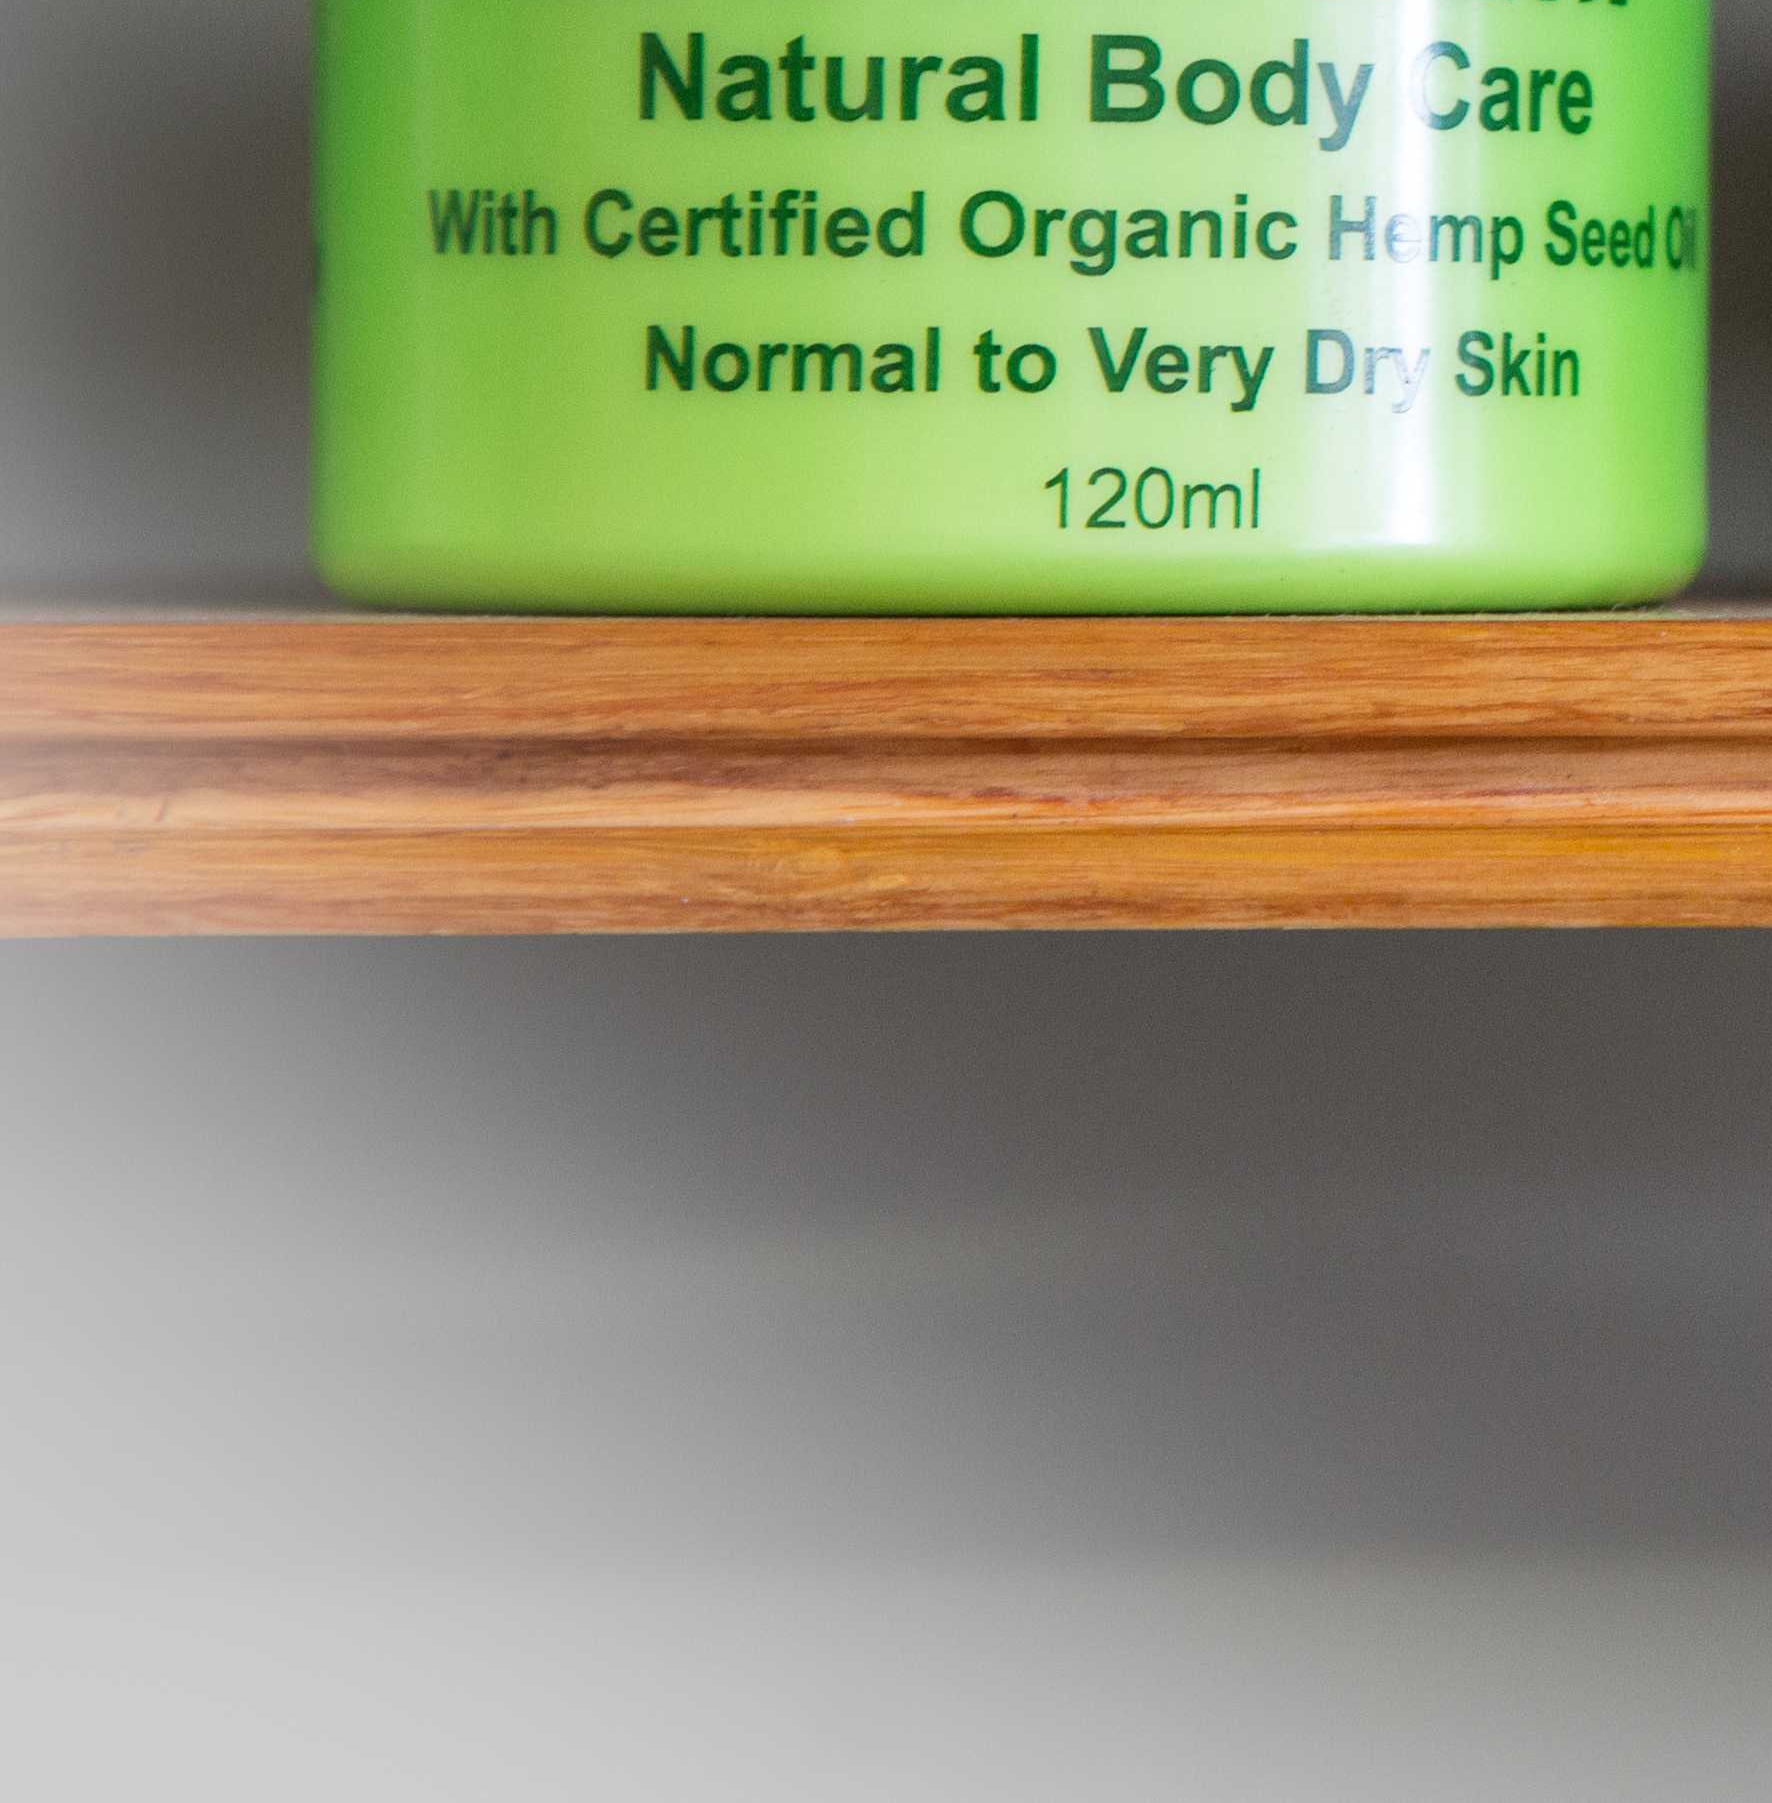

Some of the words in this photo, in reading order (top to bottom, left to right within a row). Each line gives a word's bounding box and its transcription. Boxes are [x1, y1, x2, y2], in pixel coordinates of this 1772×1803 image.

[639, 31, 1041, 124] Natural
[1089, 32, 1375, 152] Body
[1412, 40, 1595, 137] Care
[429, 188, 561, 257] With
[584, 187, 927, 260] Certified
[959, 188, 1300, 278] Organic
[1328, 193, 1527, 282] Hemp
[1543, 198, 1655, 271] Seed
[646, 323, 943, 395] Normal
[972, 328, 1059, 395] to
[1086, 325, 1276, 413] Very
[1304, 327, 1431, 414] Dry
[1454, 329, 1582, 398] Skin
[1044, 465, 1262, 530] 120ml
